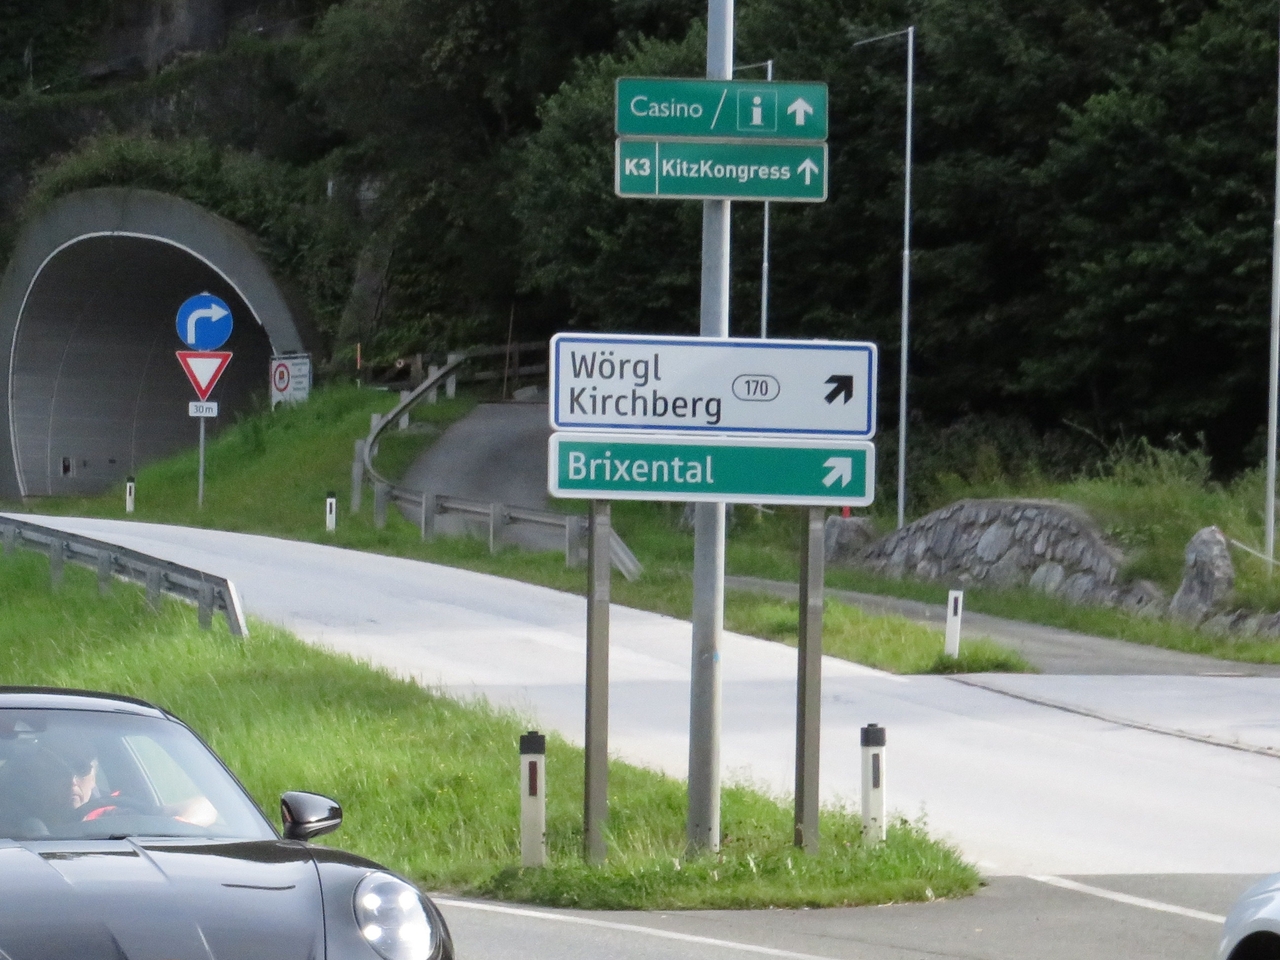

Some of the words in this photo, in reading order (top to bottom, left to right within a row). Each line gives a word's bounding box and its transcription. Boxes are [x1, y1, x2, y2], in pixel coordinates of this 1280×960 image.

[630, 95, 703, 118] Casino
[625, 158, 651, 176] K3
[662, 158, 791, 183] KitzKongress
[570, 350, 662, 387] Wörgl
[744, 379, 769, 397] 170
[194, 404, 205, 414] 30
[205, 406, 214, 414] m
[569, 386, 722, 425] Kirchberg
[568, 450, 714, 484] Brixental
